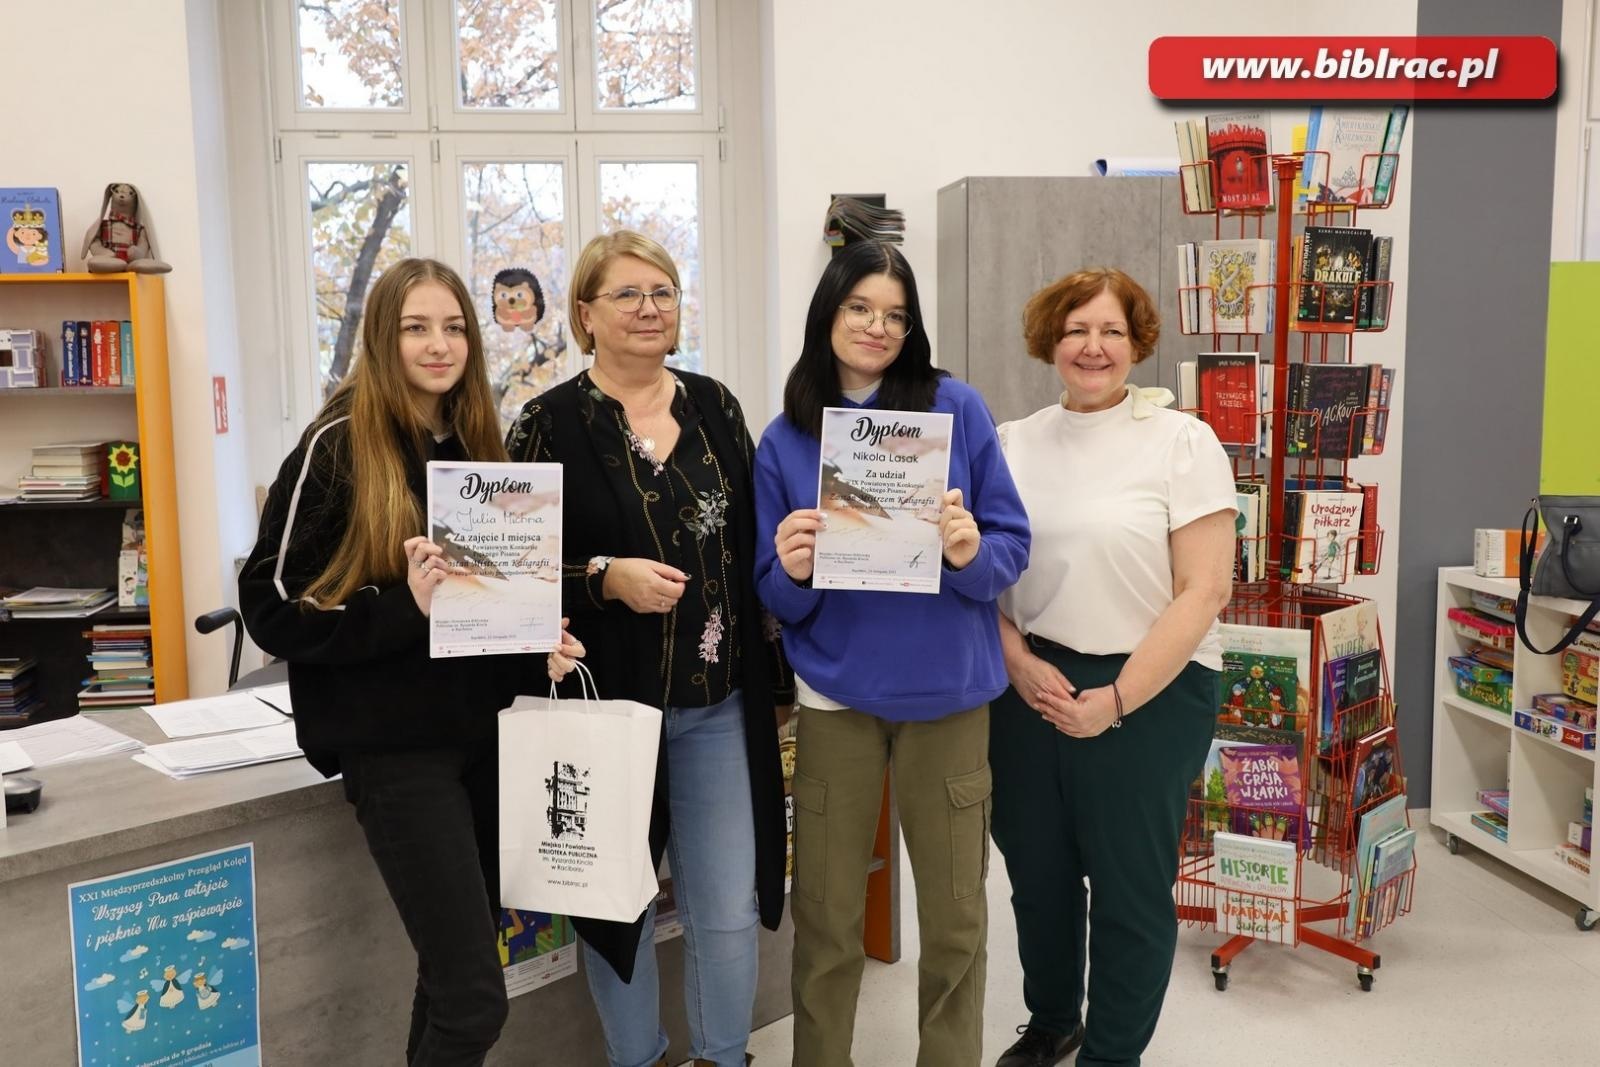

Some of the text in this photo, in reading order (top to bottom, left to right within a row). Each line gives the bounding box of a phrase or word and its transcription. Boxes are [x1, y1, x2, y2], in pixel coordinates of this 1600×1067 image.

[1310, 401, 1360, 428] BLACKOUT
[851, 416, 922, 446] Dyplom
[853, 452, 919, 463] Nikola Lasak
[865, 469, 906, 479] Za udział
[460, 473, 533, 504] Dyplom
[1311, 504, 1358, 517] Urodzony
[1314, 516, 1351, 529] piłkarz
[453, 532, 465, 542] Za
[468, 532, 499, 543] zajęcie
[508, 532, 541, 543] miejsca
[1242, 757, 1279, 773] ŻABKI
[1243, 772, 1283, 787] GRAJĄ
[1240, 785, 1288, 800] W ŁAPKI
[538, 848, 598, 858] BIBLIOTEKA PUBLICZNA
[565, 842, 595, 850] Powiatowa
[1220, 858, 1289, 885] HISTORIE
[79, 856, 247, 903] XXI Międzyprzedszkolny Przegląd Kolęd
[92, 876, 229, 921] Wszyscy Pana witajcie
[86, 896, 243, 951] i pięknie Mu zaśpiewajcie
